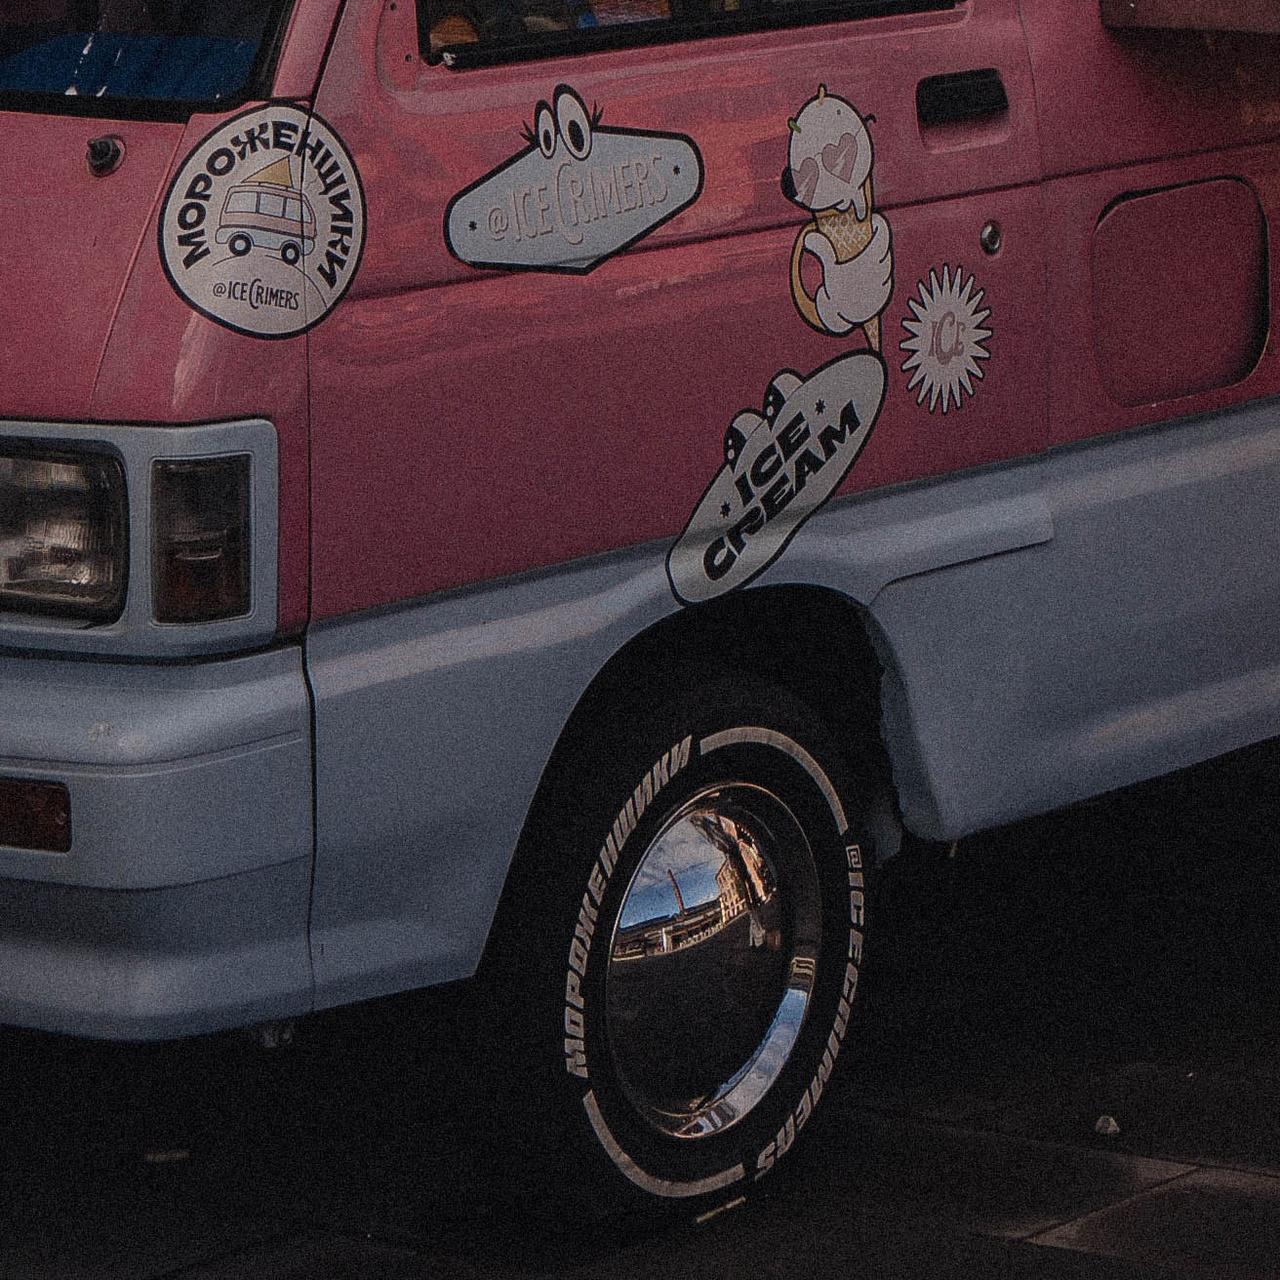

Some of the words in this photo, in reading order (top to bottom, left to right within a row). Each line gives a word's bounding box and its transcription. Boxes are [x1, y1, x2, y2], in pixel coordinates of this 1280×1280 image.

[177, 121, 353, 290] МОРОЖЕНЩИКИ
[703, 400, 861, 581] CREAM
[734, 410, 811, 507] ICE
[564, 735, 692, 1078] МОРОЖЕНЩИКИ
